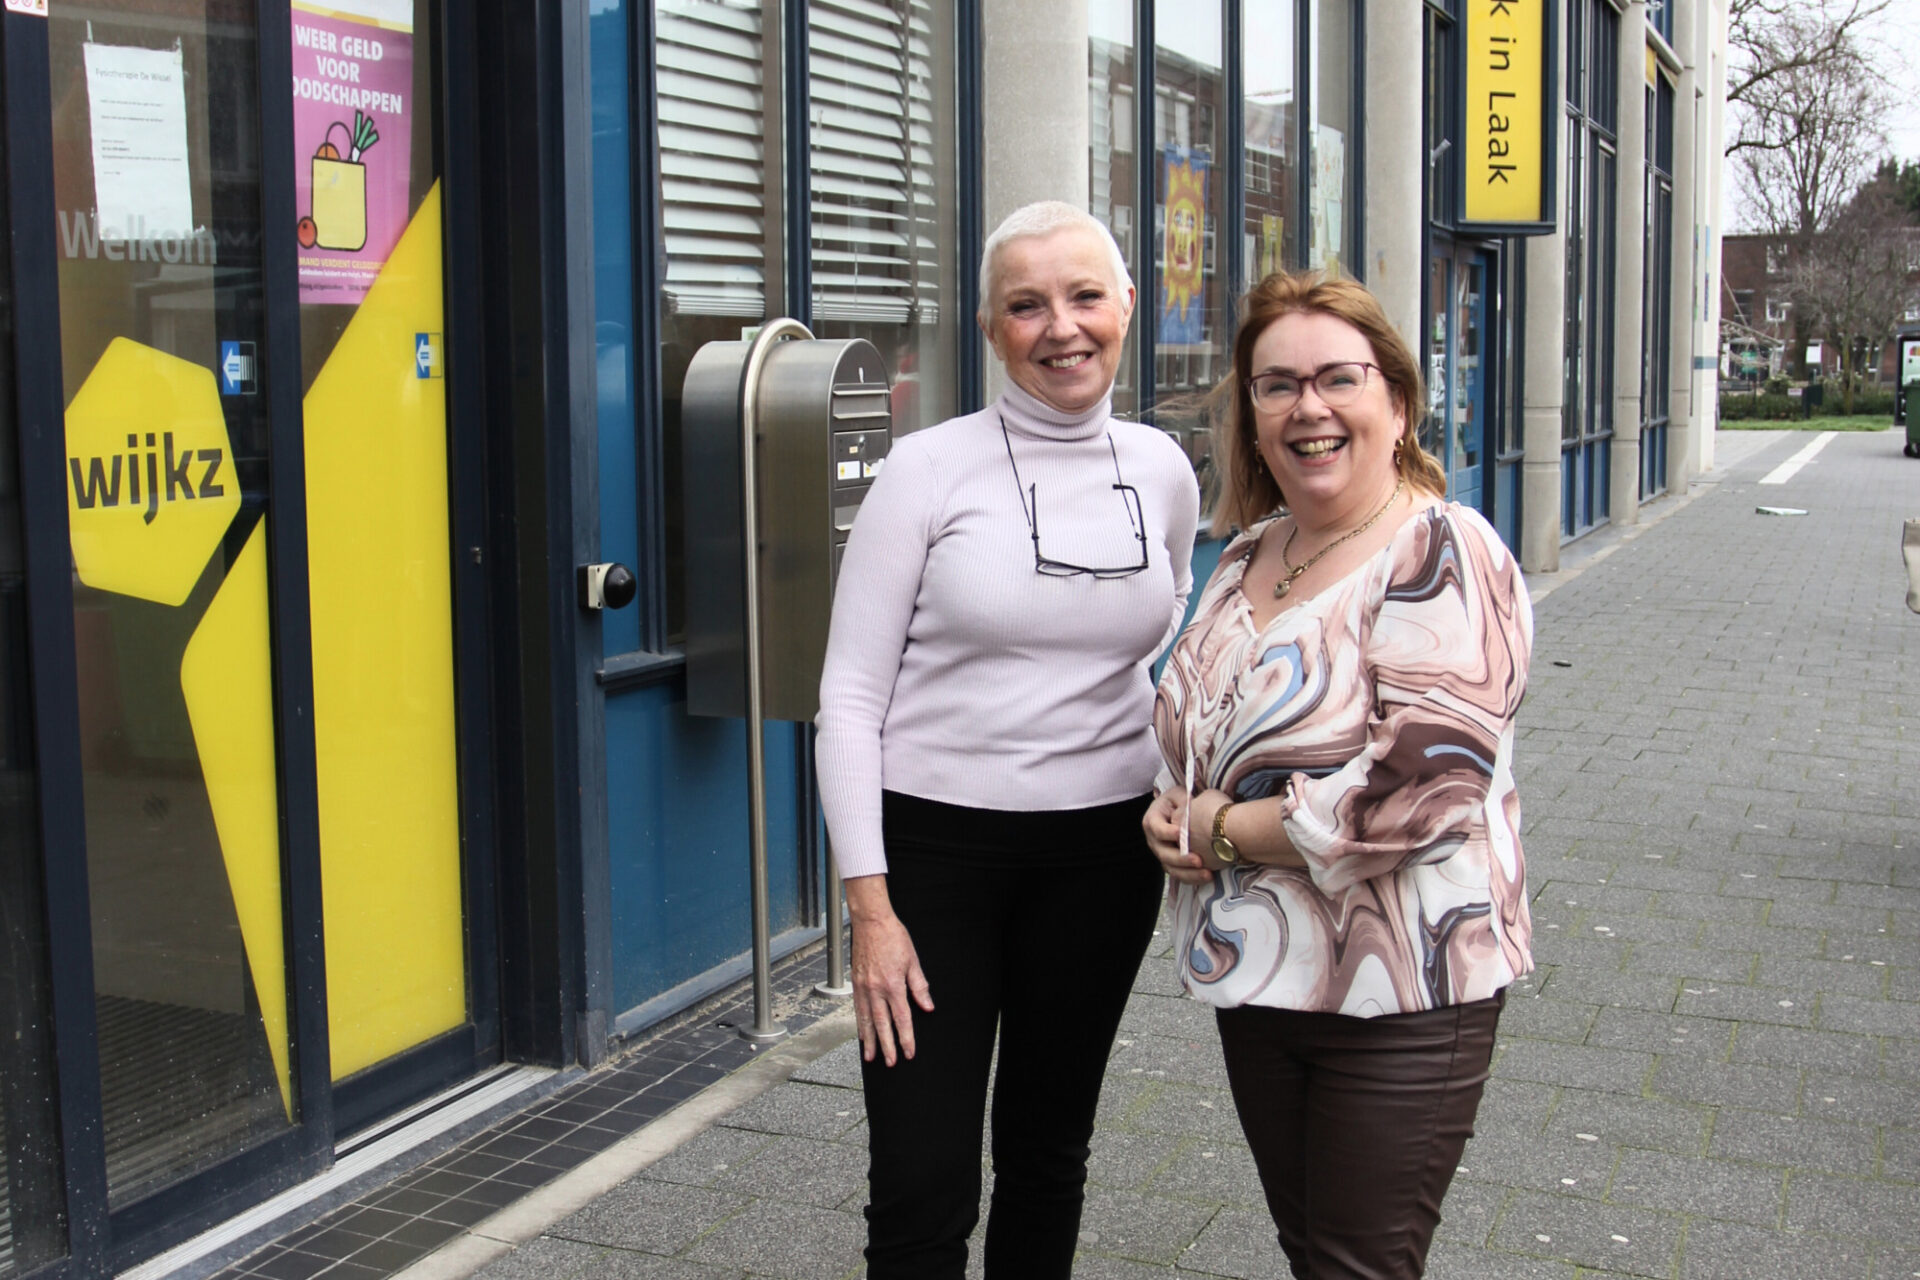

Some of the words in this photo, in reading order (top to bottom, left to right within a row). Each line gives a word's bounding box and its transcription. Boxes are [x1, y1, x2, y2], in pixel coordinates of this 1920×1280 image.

[294, 24, 338, 54] WEER
[341, 35, 383, 61] GELD
[1490, 36, 1517, 70] in
[316, 55, 360, 83] VOOR
[1488, 91, 1517, 185] Laak
[58, 210, 217, 265] Welkom
[69, 432, 224, 526] wijkz
